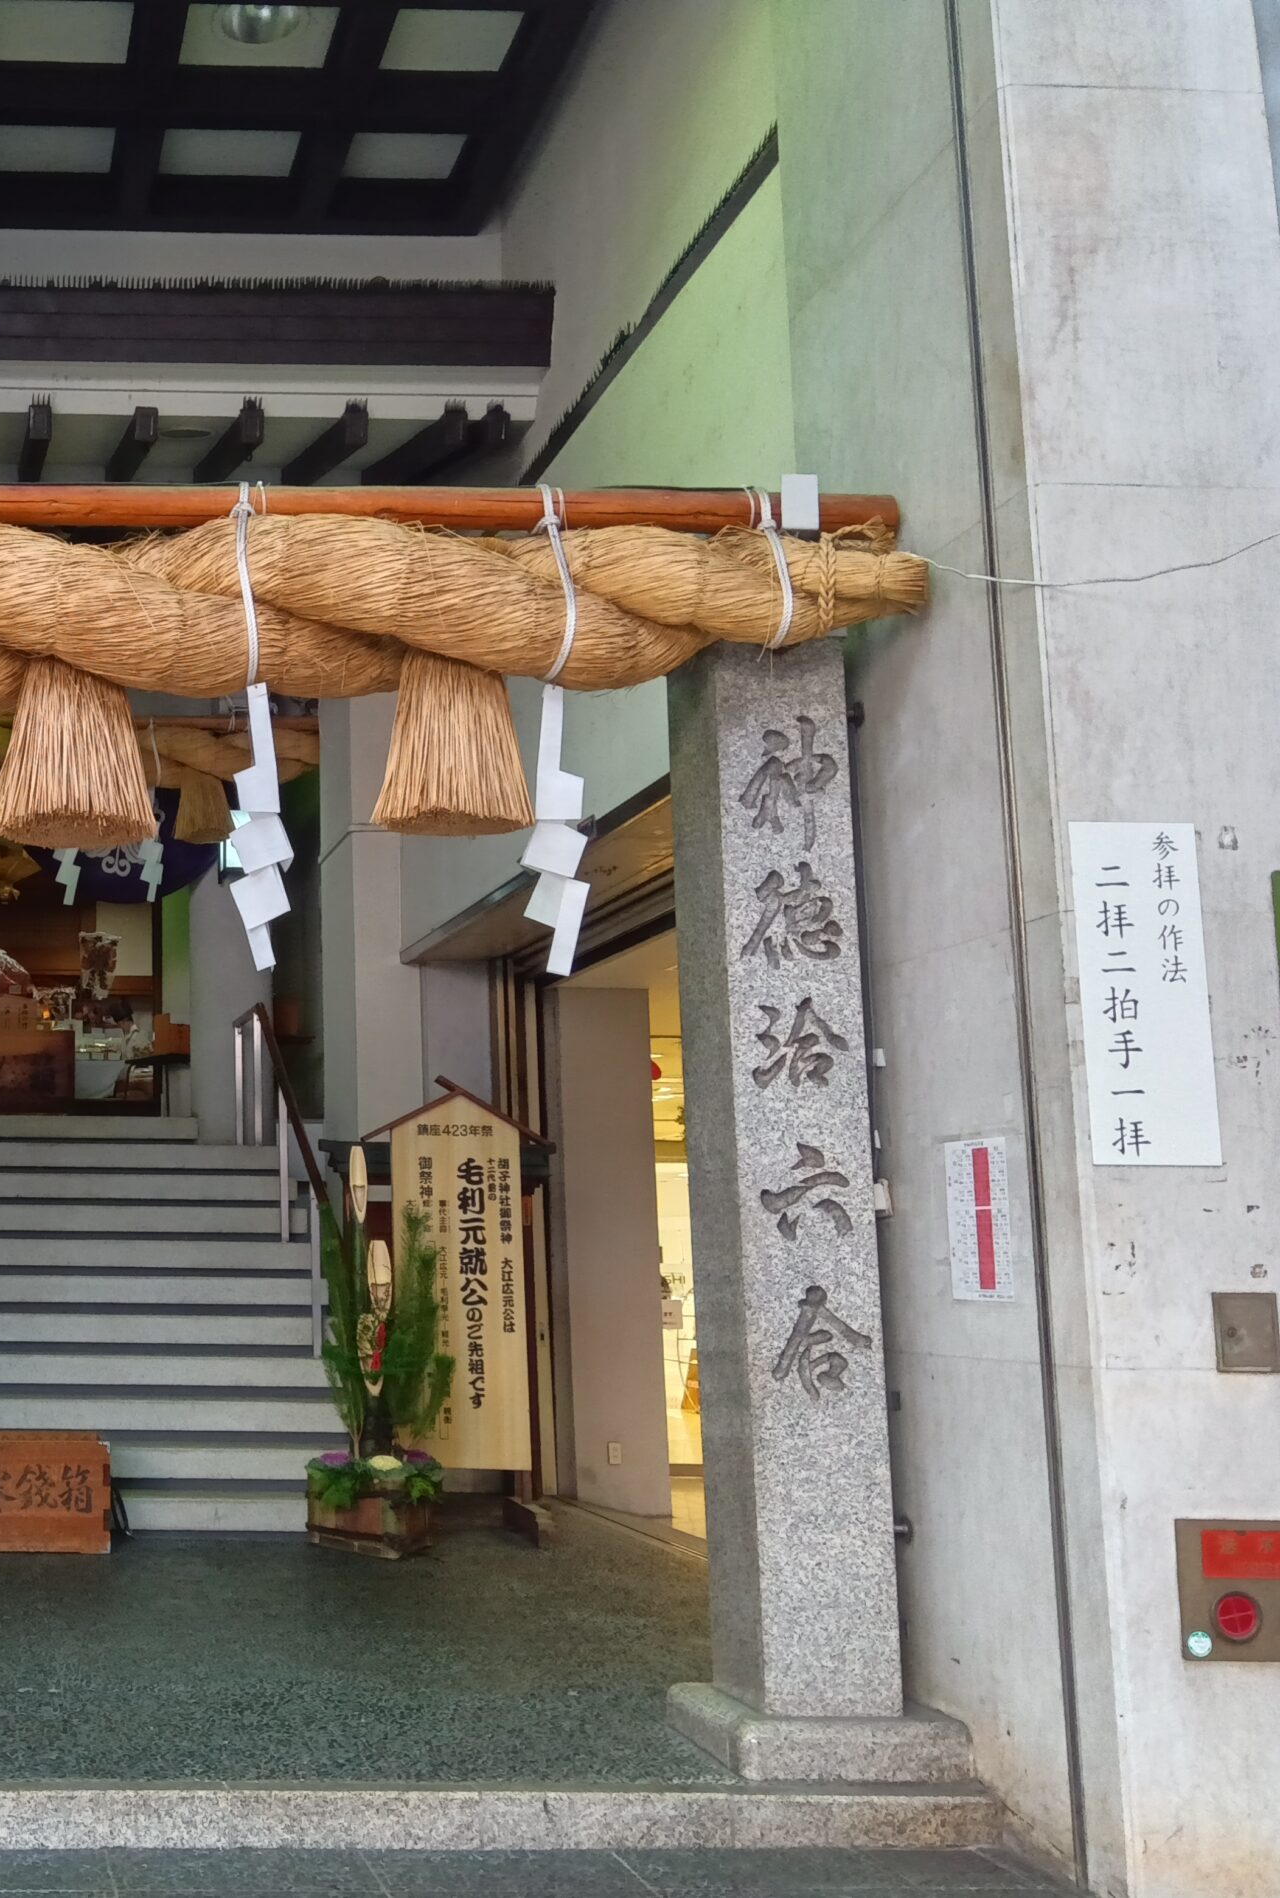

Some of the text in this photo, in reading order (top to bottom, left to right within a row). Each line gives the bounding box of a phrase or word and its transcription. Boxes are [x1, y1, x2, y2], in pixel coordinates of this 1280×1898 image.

[1150, 831, 1189, 984] 参拝の作法
[1094, 864, 1153, 1158] 二拝二拍手一拝
[417, 1123, 494, 1137] 鎮座423年祭
[418, 1156, 434, 1199] 御祭神
[457, 1157, 489, 1409] 毛利元就公のご先祖です
[497, 1157, 516, 1334] 胡子神社御祭神 大江広元公は
